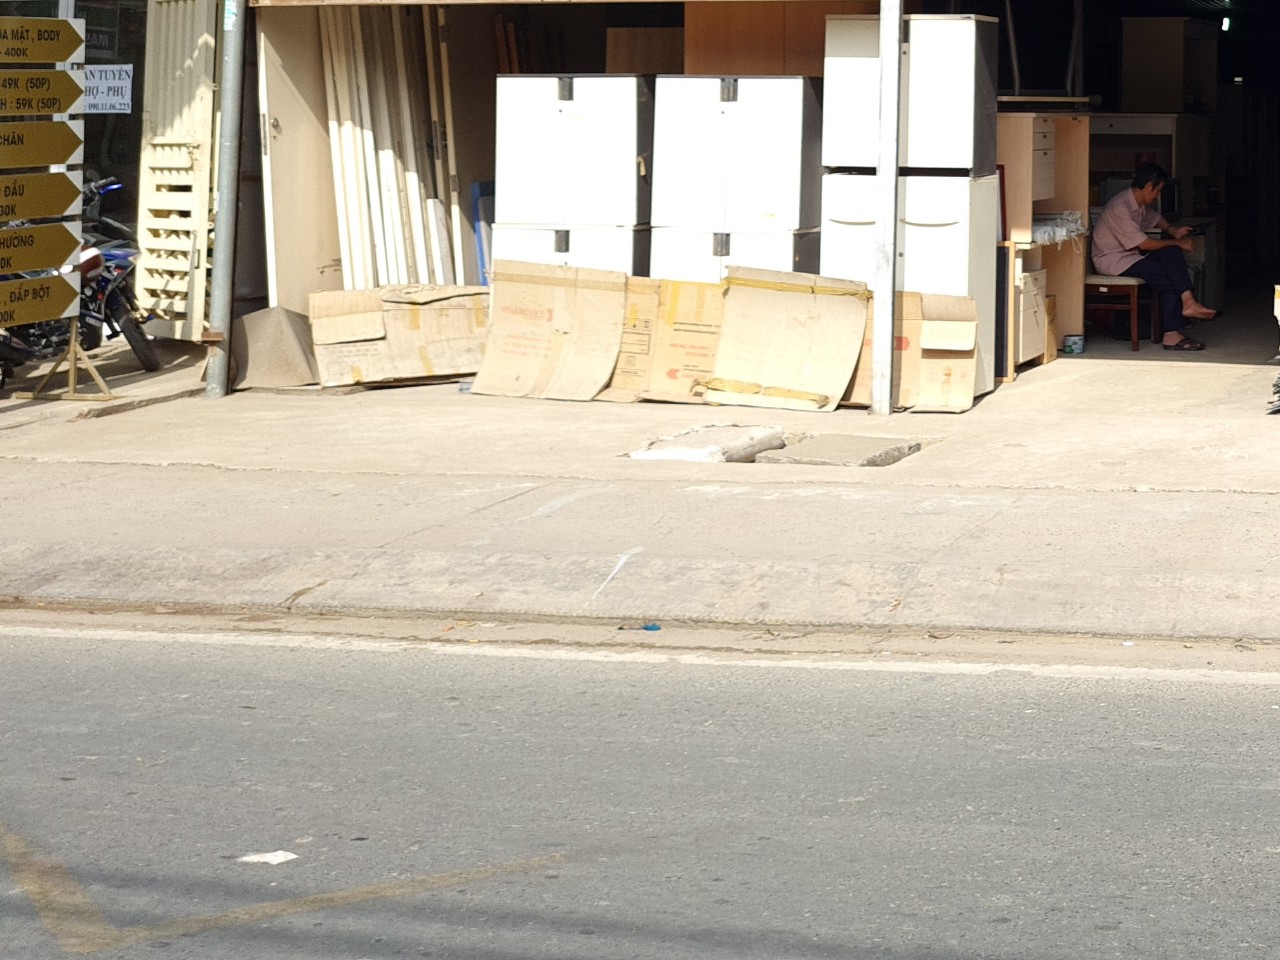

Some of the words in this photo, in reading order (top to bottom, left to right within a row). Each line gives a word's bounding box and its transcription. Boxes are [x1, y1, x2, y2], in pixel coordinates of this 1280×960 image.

[11, 25, 30, 44] MẶT
[37, 29, 61, 42] BODY
[4, 47, 29, 58] 400K
[1, 77, 20, 90] 49K
[26, 77, 51, 92] (50P)
[16, 98, 34, 110] 59K
[37, 97, 61, 112] (50P)
